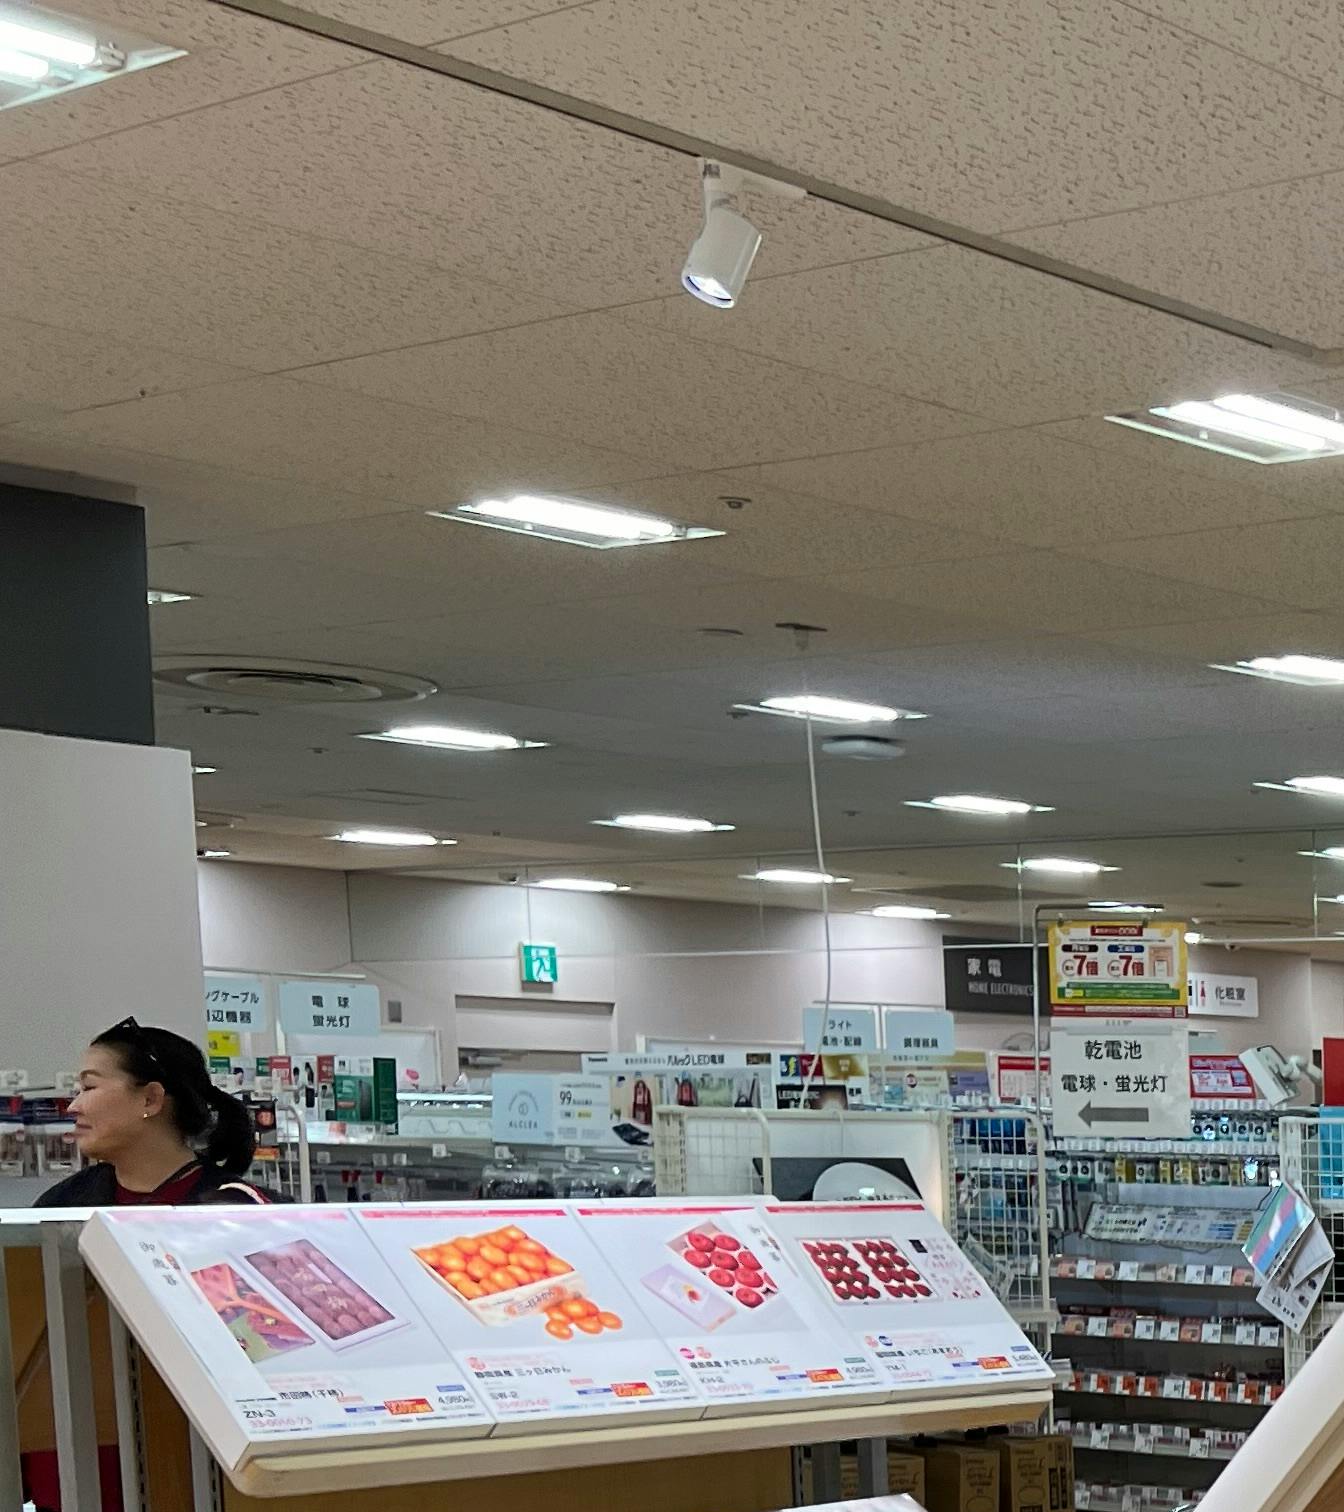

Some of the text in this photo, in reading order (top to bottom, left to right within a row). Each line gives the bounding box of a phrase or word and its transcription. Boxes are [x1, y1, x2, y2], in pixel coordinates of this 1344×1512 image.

[967, 958, 1002, 977] 家電
[207, 1009, 251, 1024] 辺機器
[1085, 1040, 1142, 1060] 乾電池
[1061, 1075, 1168, 1093] 電球・蛍光灯
